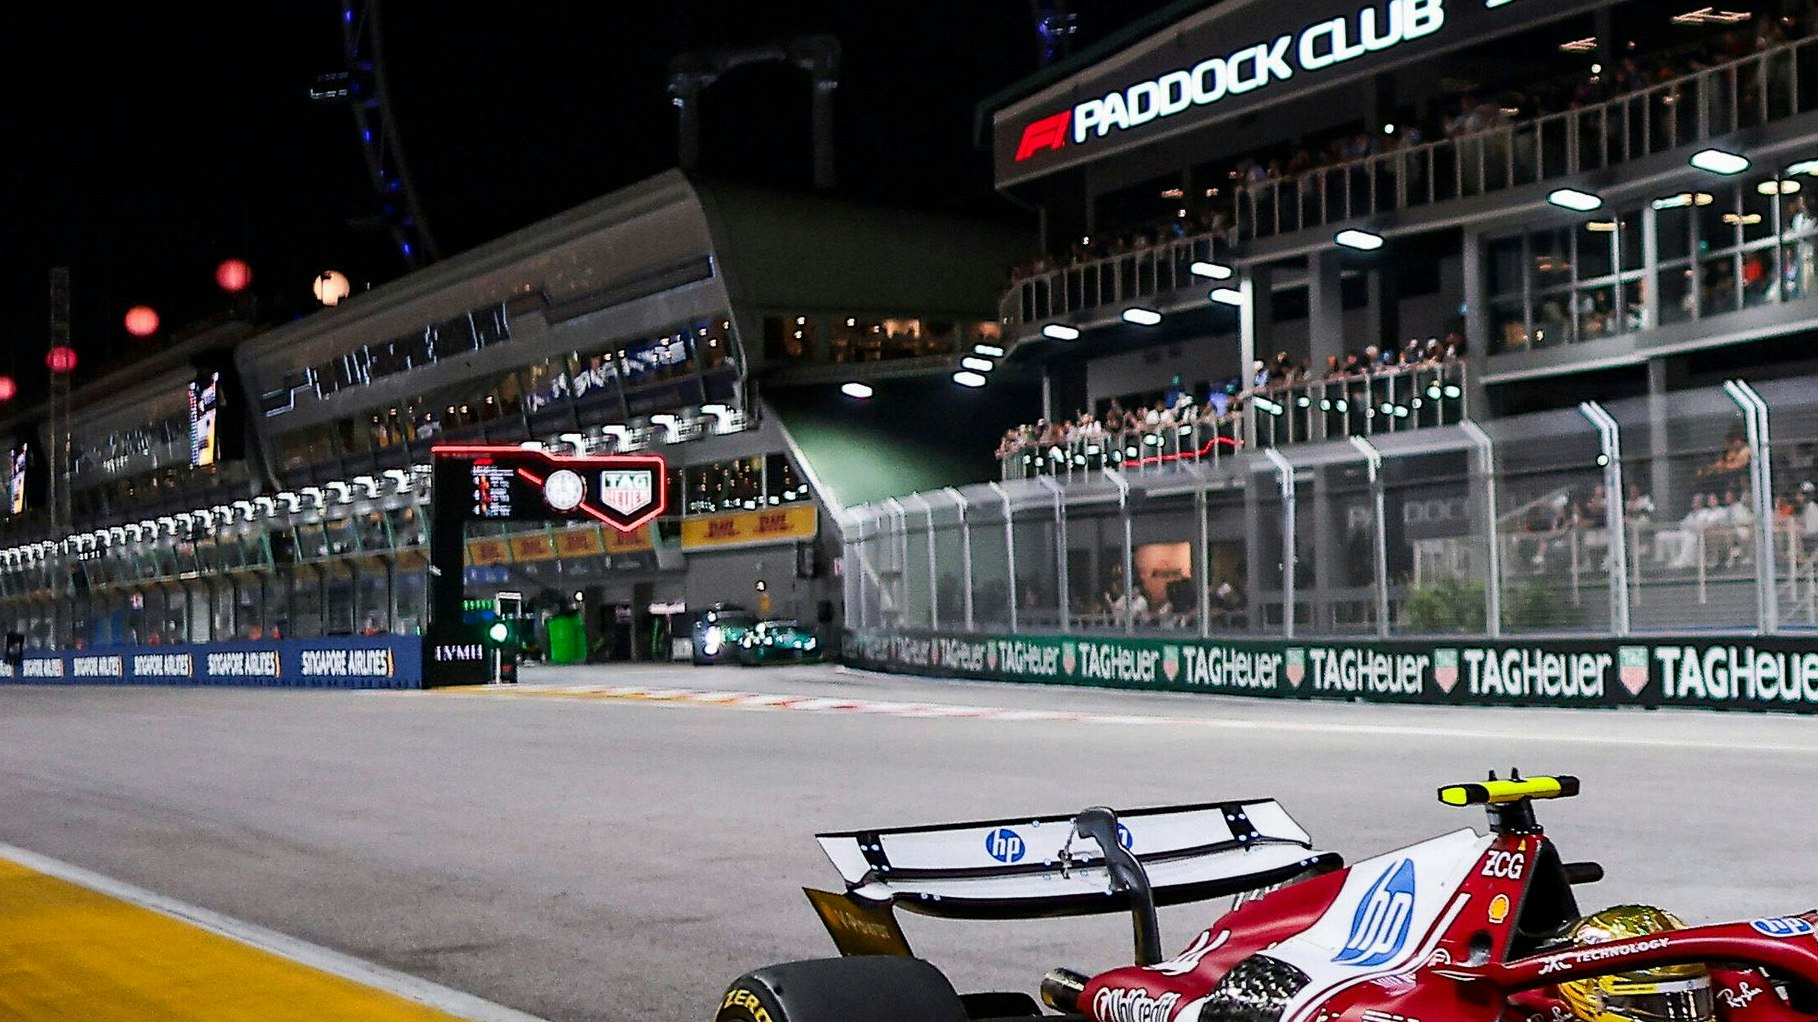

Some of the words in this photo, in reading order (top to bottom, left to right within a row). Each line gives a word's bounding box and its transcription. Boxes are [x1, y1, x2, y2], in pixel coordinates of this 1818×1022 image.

[1074, 35, 1292, 143] PADDOCK
[1299, 0, 1447, 69] CLUB
[302, 649, 346, 676] SINGAPORE
[348, 649, 388, 676] AIRLINES
[988, 828, 1024, 862] hp
[1481, 849, 1525, 880] ZCG
[1575, 938, 1670, 963] TECHNOLOGY
